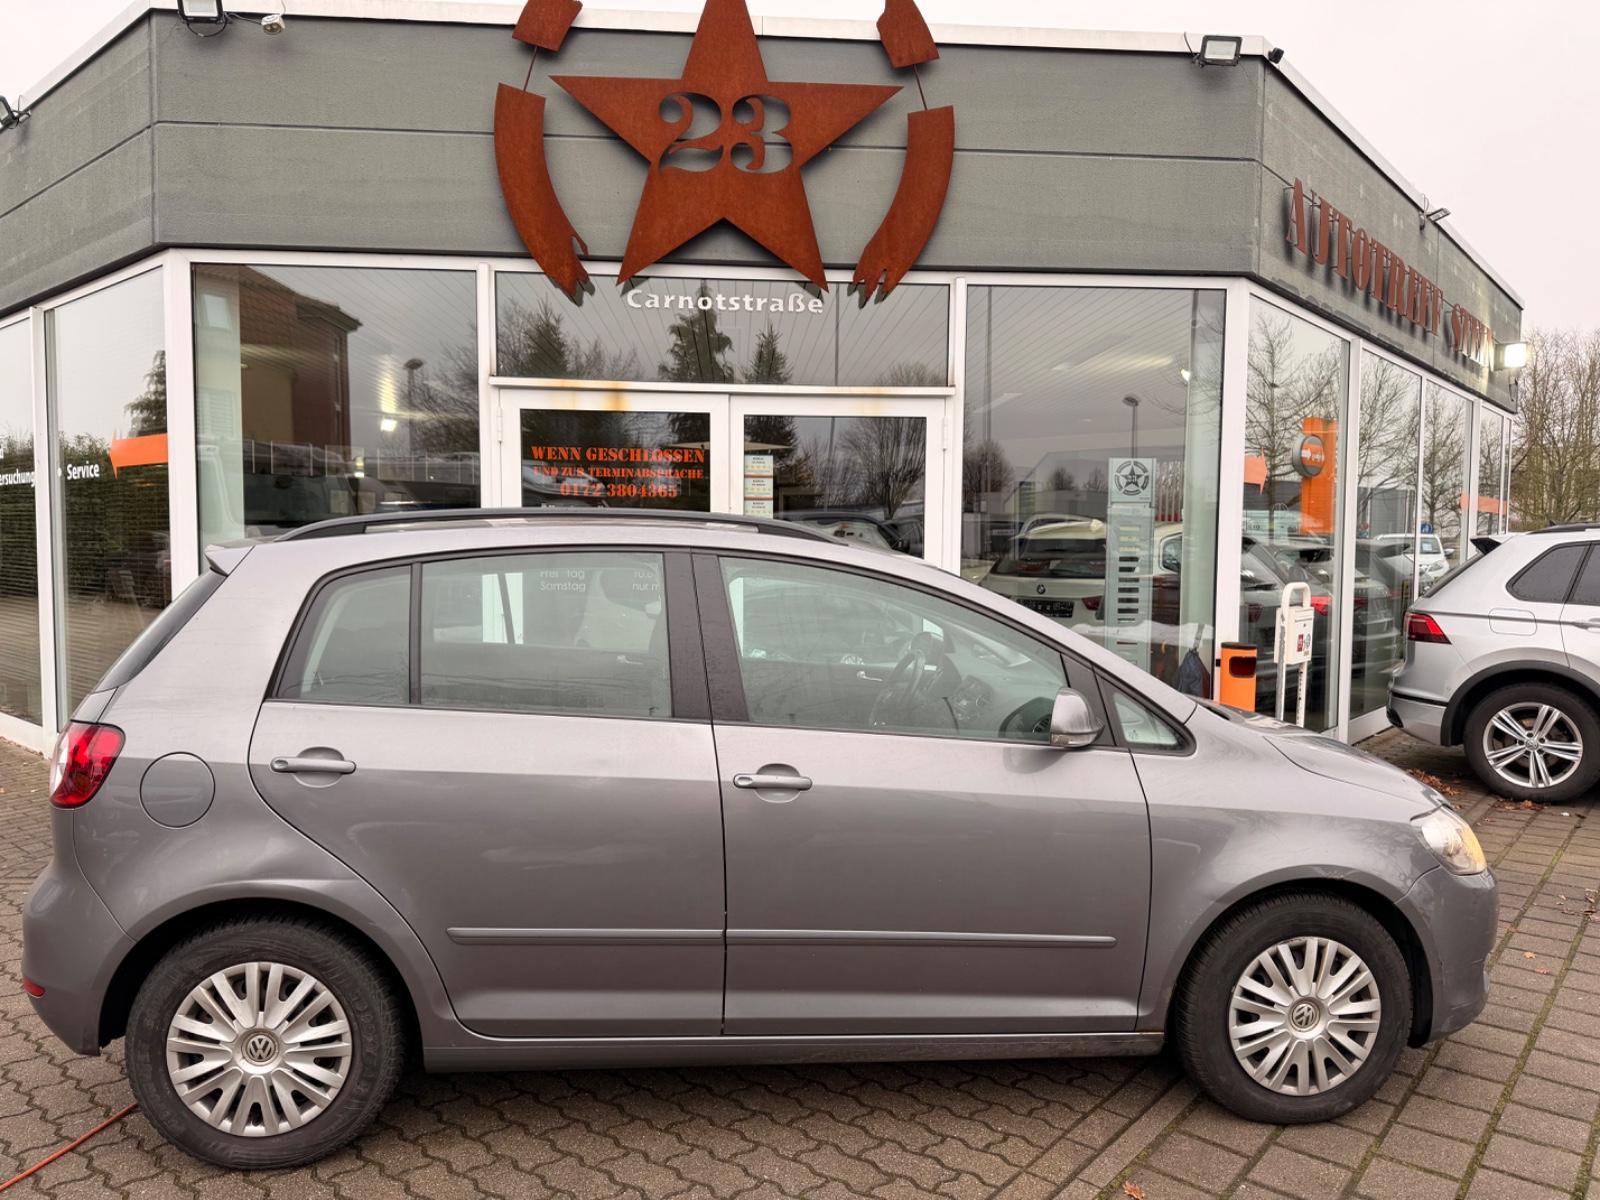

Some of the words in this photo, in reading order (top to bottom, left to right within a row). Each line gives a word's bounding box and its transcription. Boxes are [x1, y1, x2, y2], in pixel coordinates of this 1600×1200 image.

[658, 91, 794, 175] 23
[626, 289, 824, 314] Carnotstraße
[531, 446, 582, 461] WENN
[585, 447, 705, 463] GESCHLOSSEN
[66, 460, 100, 480] Service
[533, 466, 559, 476] UND
[588, 467, 705, 480] TERMINABSPRACHE
[559, 483, 601, 498] 0172
[606, 483, 678, 499] 3804365
[539, 580, 586, 592] Samstag
